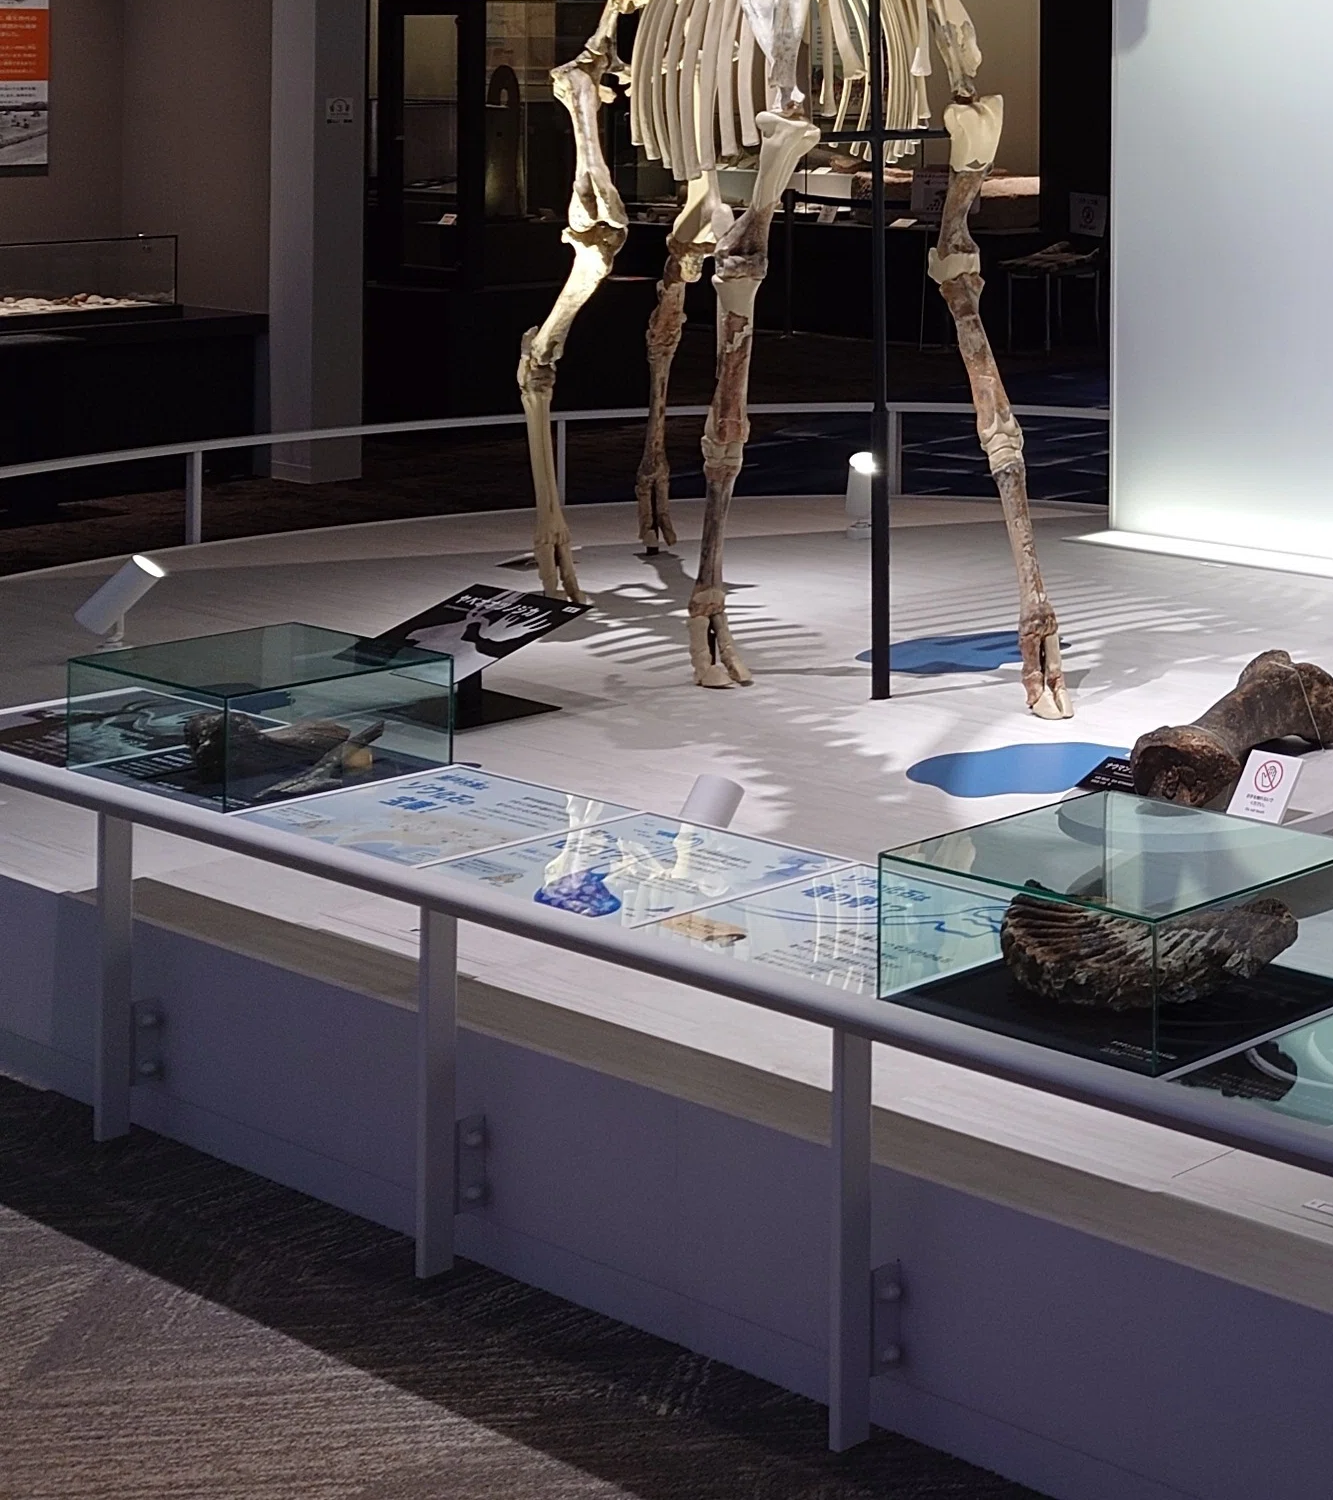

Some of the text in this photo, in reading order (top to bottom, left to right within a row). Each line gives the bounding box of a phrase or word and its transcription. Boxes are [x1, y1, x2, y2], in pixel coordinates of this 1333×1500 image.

[456, 594, 540, 618] ヤベオオツノジカ
[1105, 762, 1132, 774] ナウマン
